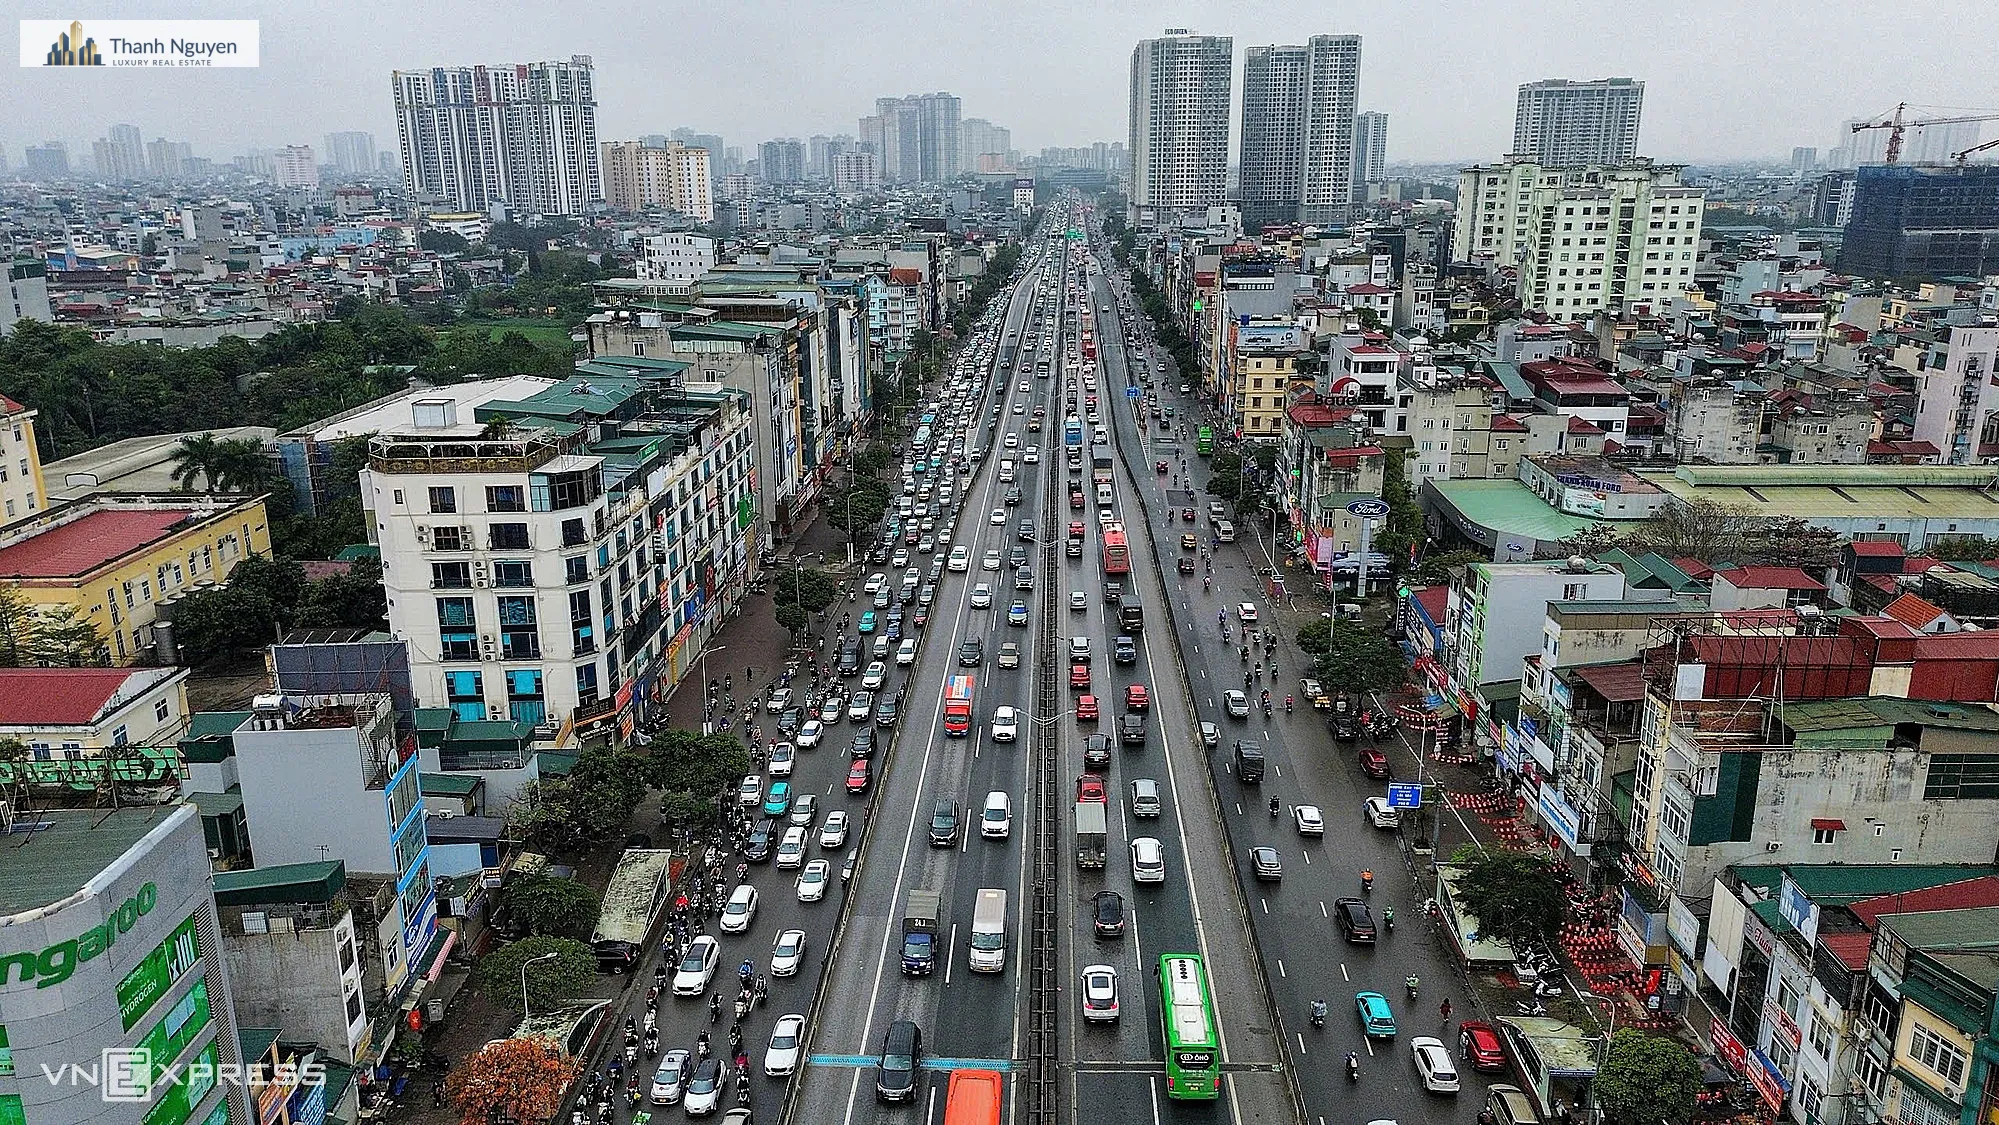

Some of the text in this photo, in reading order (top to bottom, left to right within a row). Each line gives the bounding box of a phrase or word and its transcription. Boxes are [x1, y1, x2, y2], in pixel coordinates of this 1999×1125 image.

[1601, 481, 1622, 493] FORD
[1354, 503, 1382, 513] Ford
[119, 978, 158, 1021] HYDROGEN
